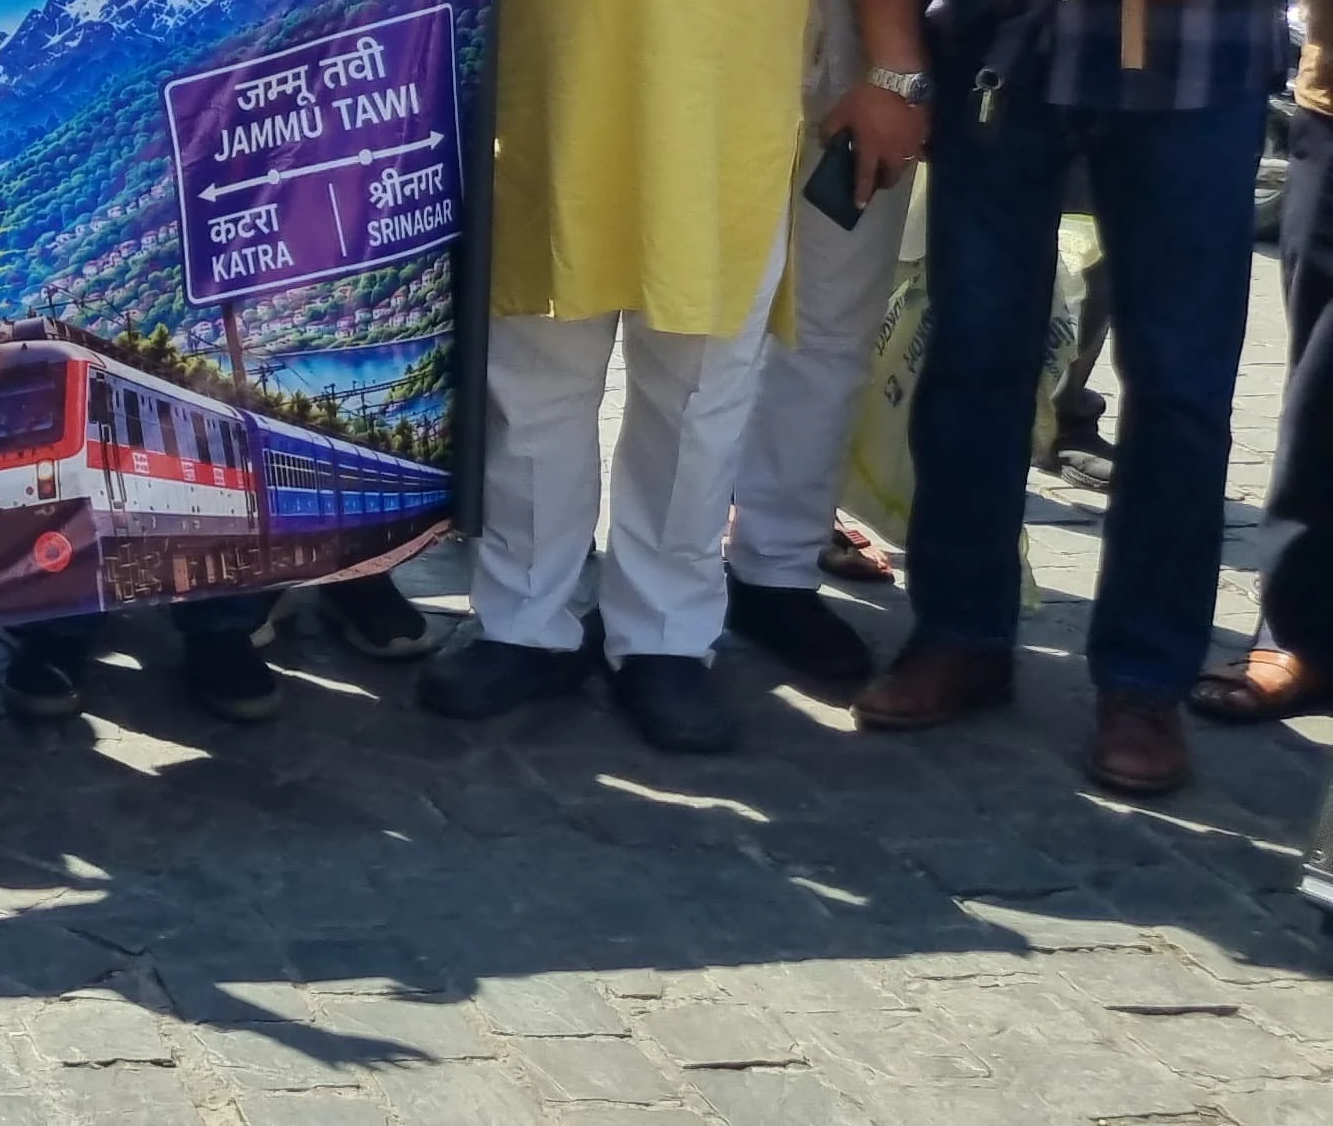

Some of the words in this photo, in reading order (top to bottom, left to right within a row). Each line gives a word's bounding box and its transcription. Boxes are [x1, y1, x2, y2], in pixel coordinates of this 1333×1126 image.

[234, 64, 316, 112] जम्मू
[319, 36, 387, 90] तवी
[214, 106, 324, 162] JAMMU
[332, 82, 420, 132] TAWI
[207, 202, 281, 246] कटरा
[368, 162, 444, 211] श्रीनगर
[211, 240, 295, 283] KATRA
[367, 198, 453, 248] SRINAGAR
